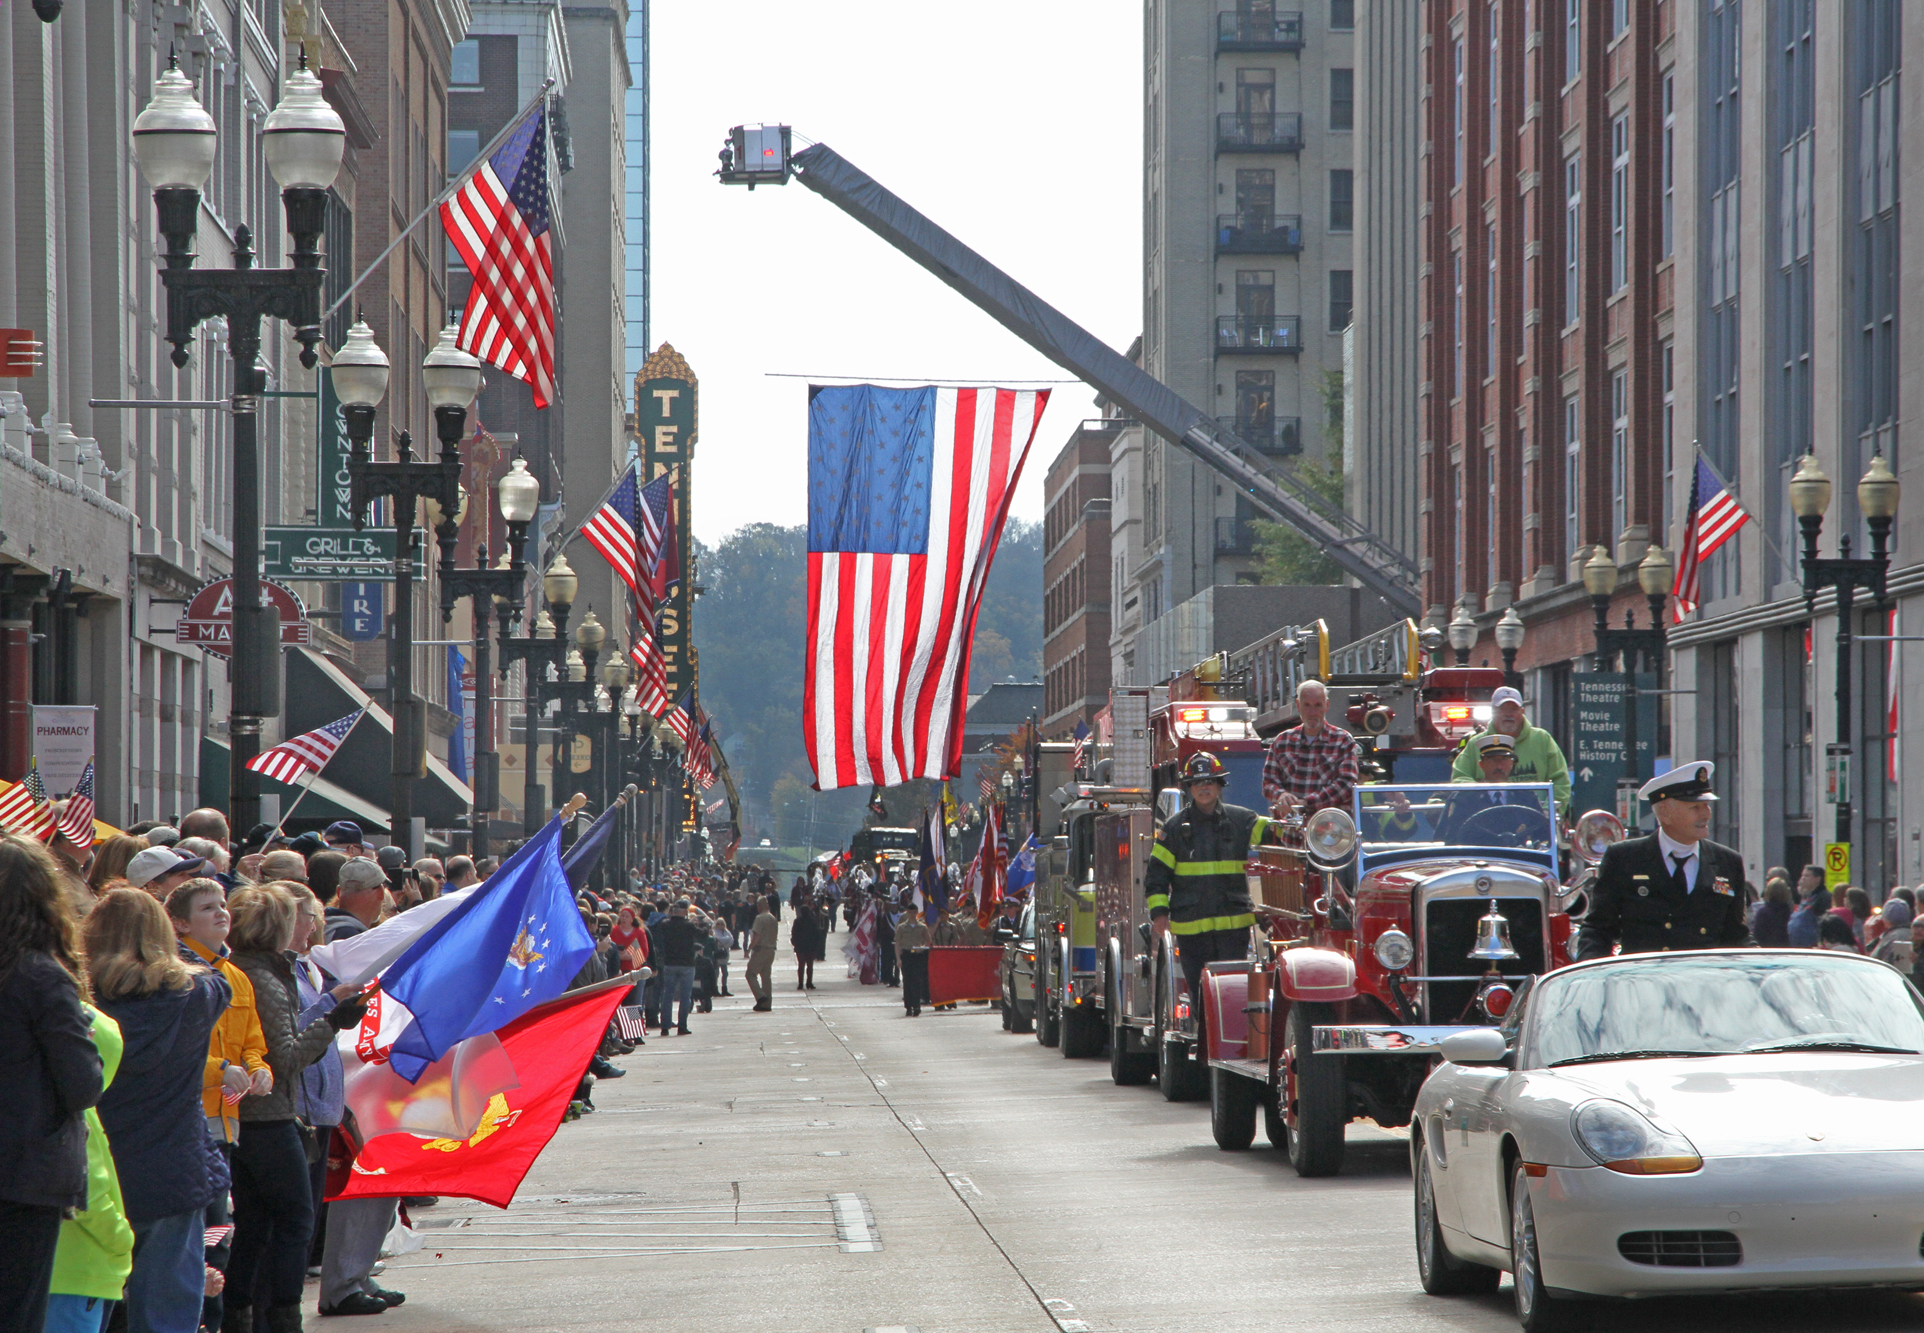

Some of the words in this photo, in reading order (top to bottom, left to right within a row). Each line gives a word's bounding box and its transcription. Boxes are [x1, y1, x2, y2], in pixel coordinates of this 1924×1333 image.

[305, 536, 361, 555] GRILL
[198, 624, 288, 641] MAT
[1580, 693, 1620, 703] Theatre
[1580, 711, 1610, 721] Movie
[36, 726, 90, 736] PHARMACY
[1580, 722, 1621, 732] Theatre
[1579, 740, 1589, 750] E.
[1592, 740, 1649, 750] Tenneee
[1579, 751, 1617, 763] History
[1197, 764, 1204, 772] 5
